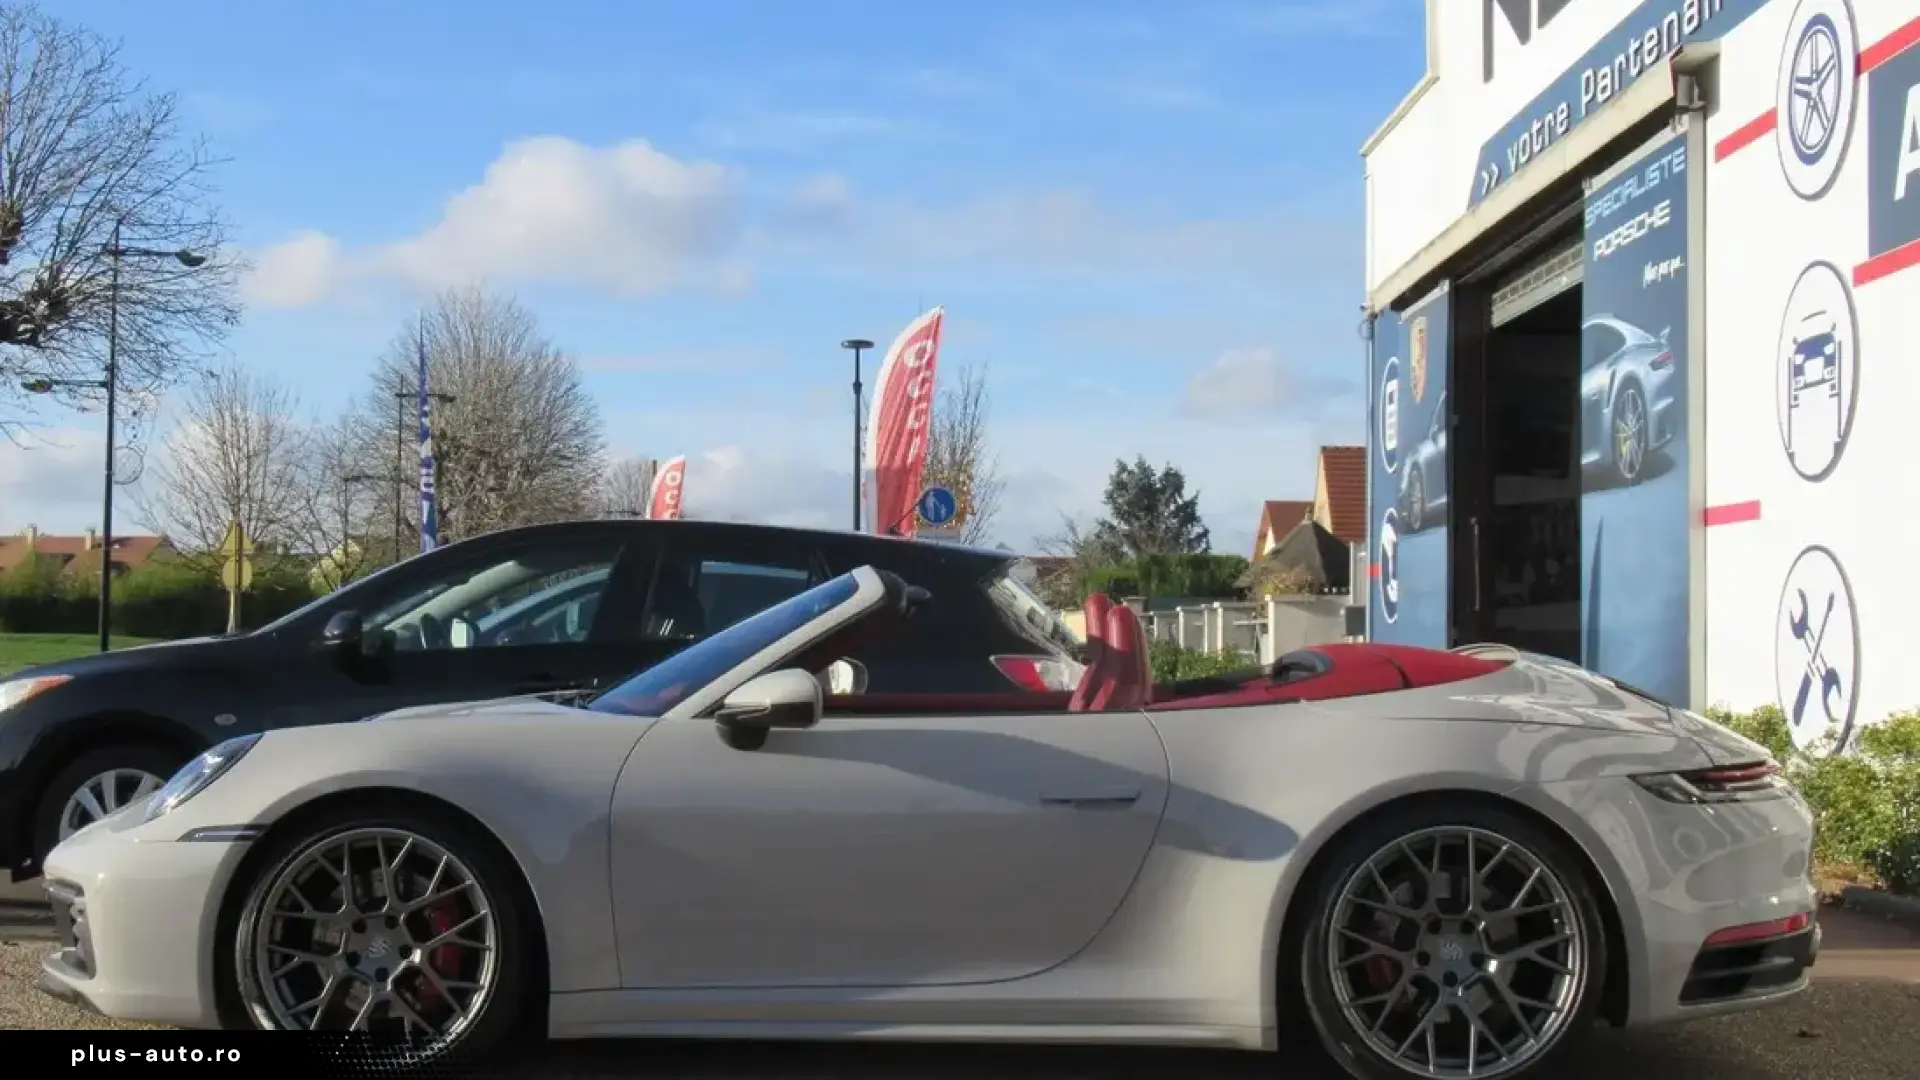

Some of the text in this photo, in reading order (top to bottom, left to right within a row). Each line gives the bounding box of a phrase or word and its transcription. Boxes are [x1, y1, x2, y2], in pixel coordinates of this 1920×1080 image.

[1508, 101, 1569, 172] votre
[1584, 145, 1685, 229] SPECIALISTE
[1593, 199, 1671, 261] PORSCHE
